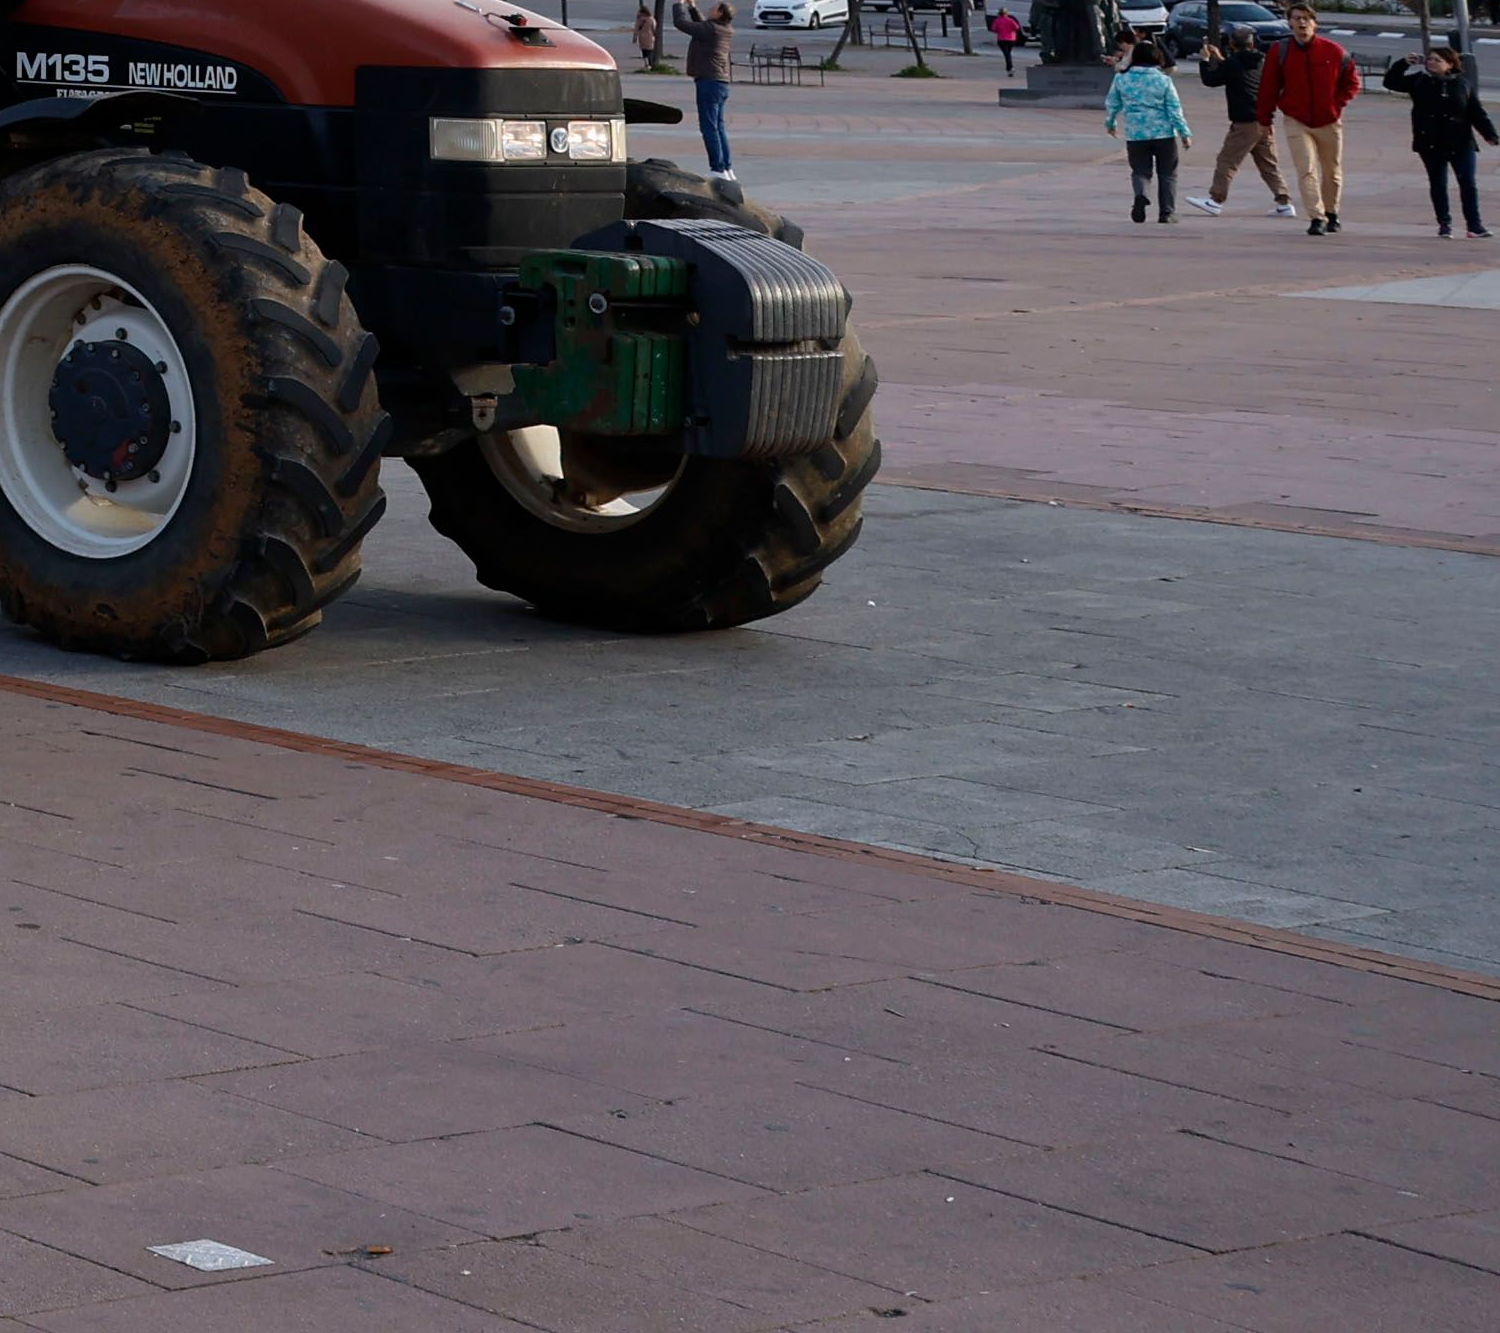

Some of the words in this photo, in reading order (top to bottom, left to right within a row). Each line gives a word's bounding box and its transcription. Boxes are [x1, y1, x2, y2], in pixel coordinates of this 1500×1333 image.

[16, 51, 110, 83] M135
[128, 62, 162, 86] NEW
[163, 63, 238, 90] HOLLAND
